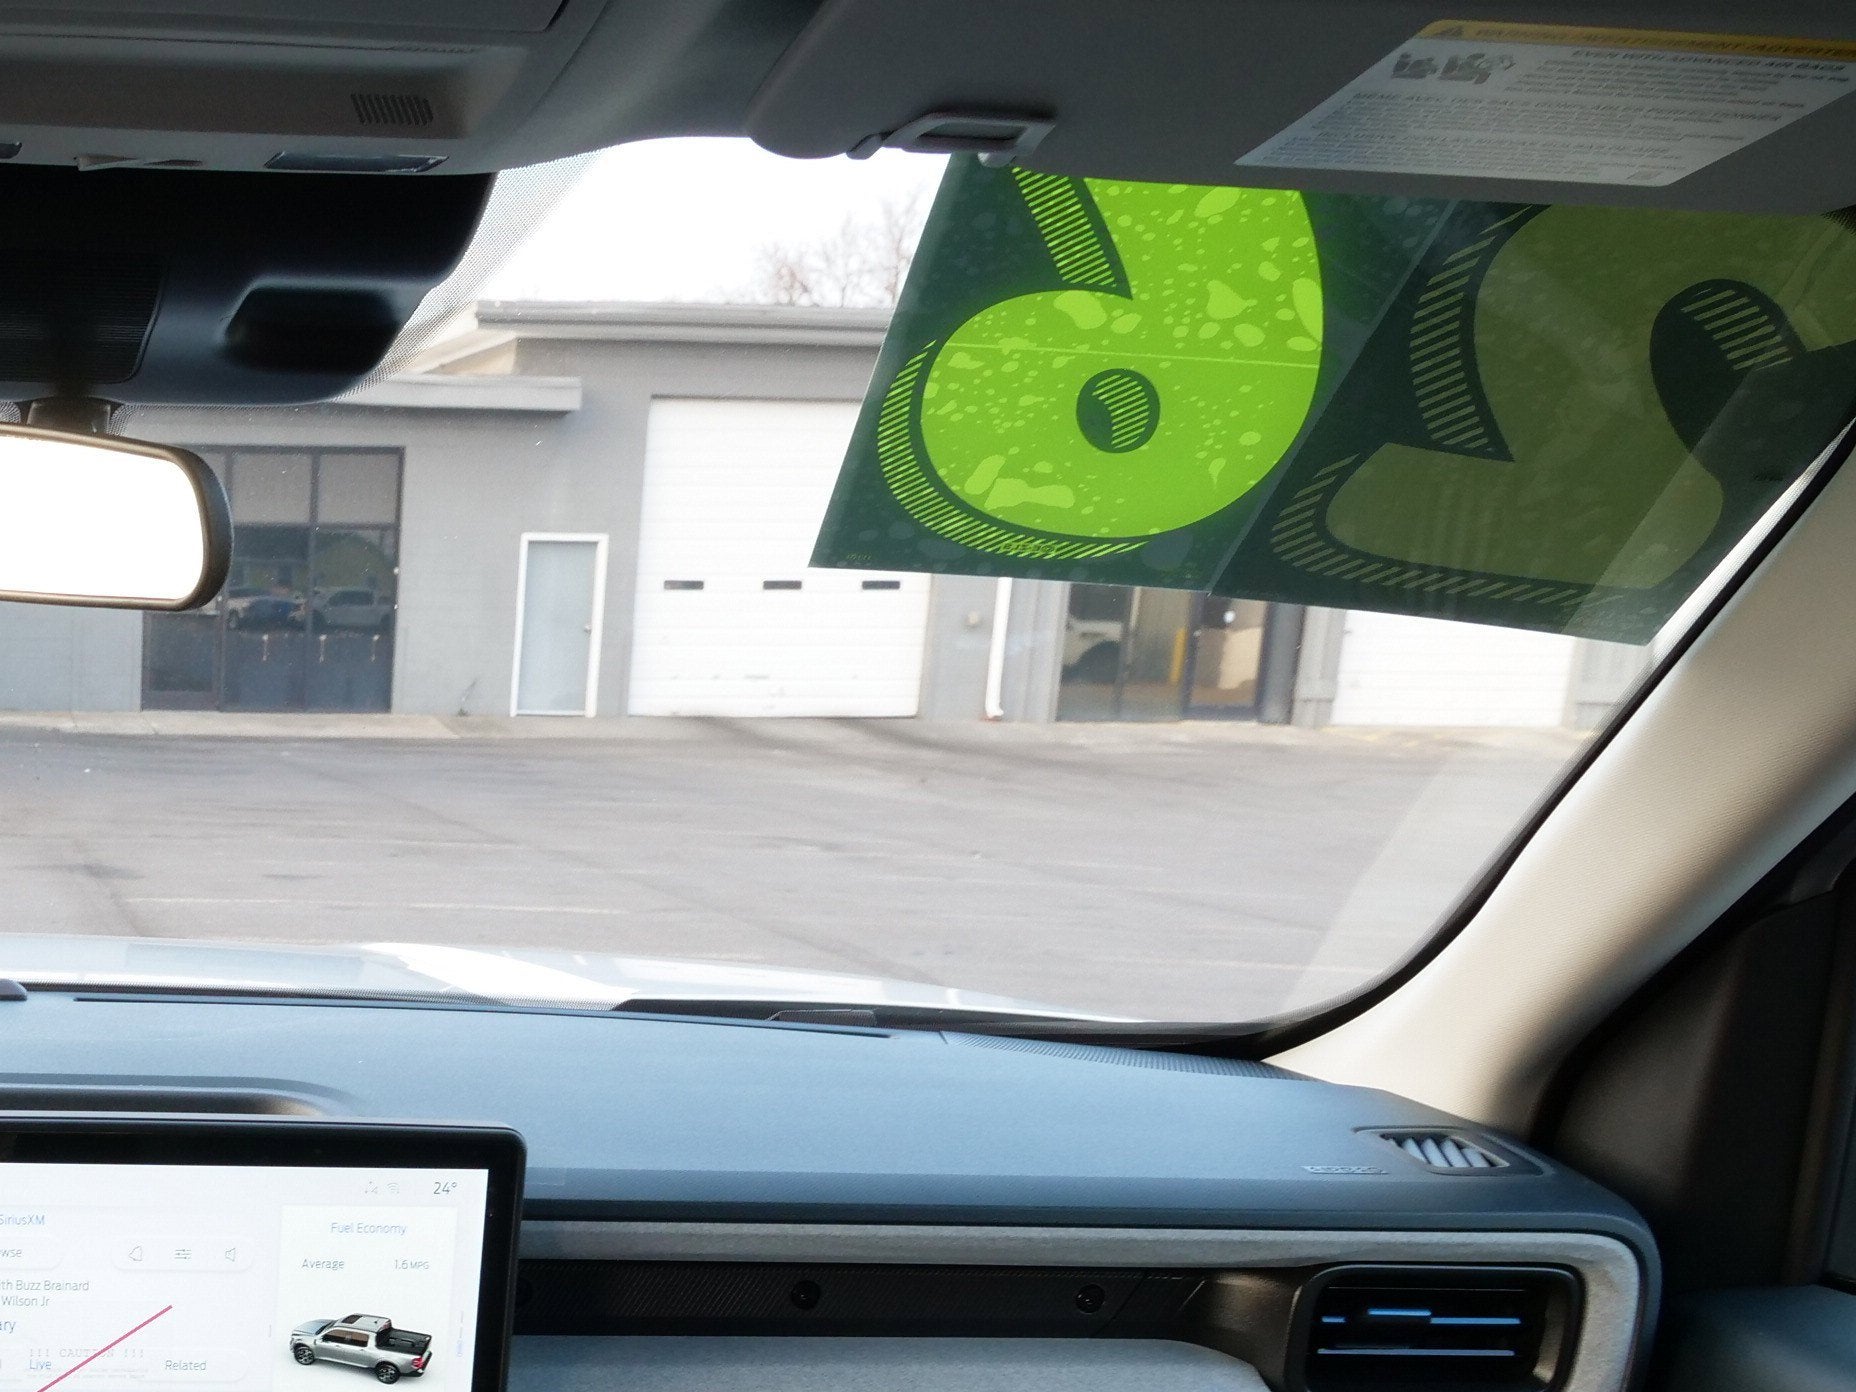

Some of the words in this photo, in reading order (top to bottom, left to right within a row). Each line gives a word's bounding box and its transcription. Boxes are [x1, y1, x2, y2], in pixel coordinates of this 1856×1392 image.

[331, 1222, 355, 1234] Fuel
[356, 1222, 407, 1235] Economy
[301, 1258, 345, 1271] Average
[16, 1280, 41, 1291] Buzz
[44, 1280, 90, 1292] Brainard
[1, 1295, 38, 1307] Wilson
[40, 1296, 50, 1307] Jr
[29, 1359, 52, 1371] Live
[165, 1360, 207, 1371] Related
